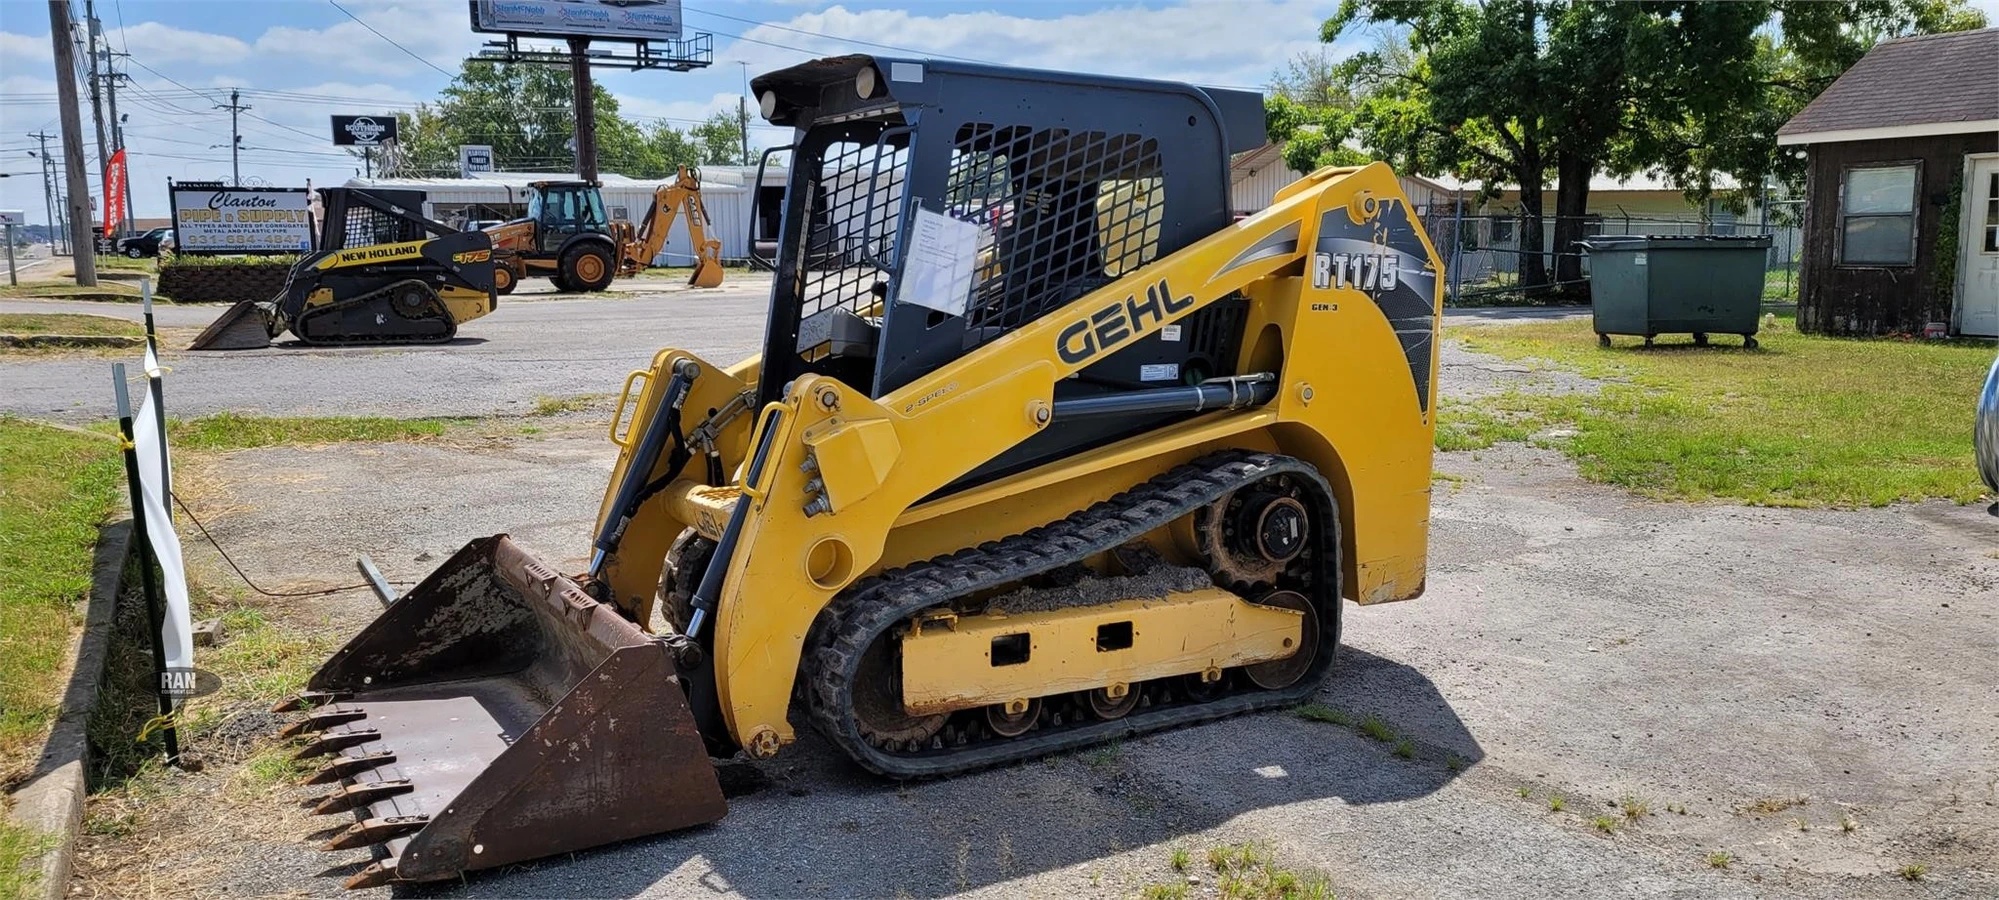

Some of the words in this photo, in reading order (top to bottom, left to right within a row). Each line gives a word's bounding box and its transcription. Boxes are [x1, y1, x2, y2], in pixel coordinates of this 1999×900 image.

[344, 124, 385, 132] SOUTHERN
[208, 191, 277, 209] Clanton
[180, 209, 221, 223] PIPE
[237, 209, 306, 223] SUPPLY
[188, 235, 302, 244] 931-684-4847
[342, 252, 367, 262] NEW
[369, 245, 417, 259] HOLLAND
[1313, 252, 1400, 291] RT175
[1056, 278, 1195, 365] GEHL
[905, 382, 959, 413] 2-SPE
